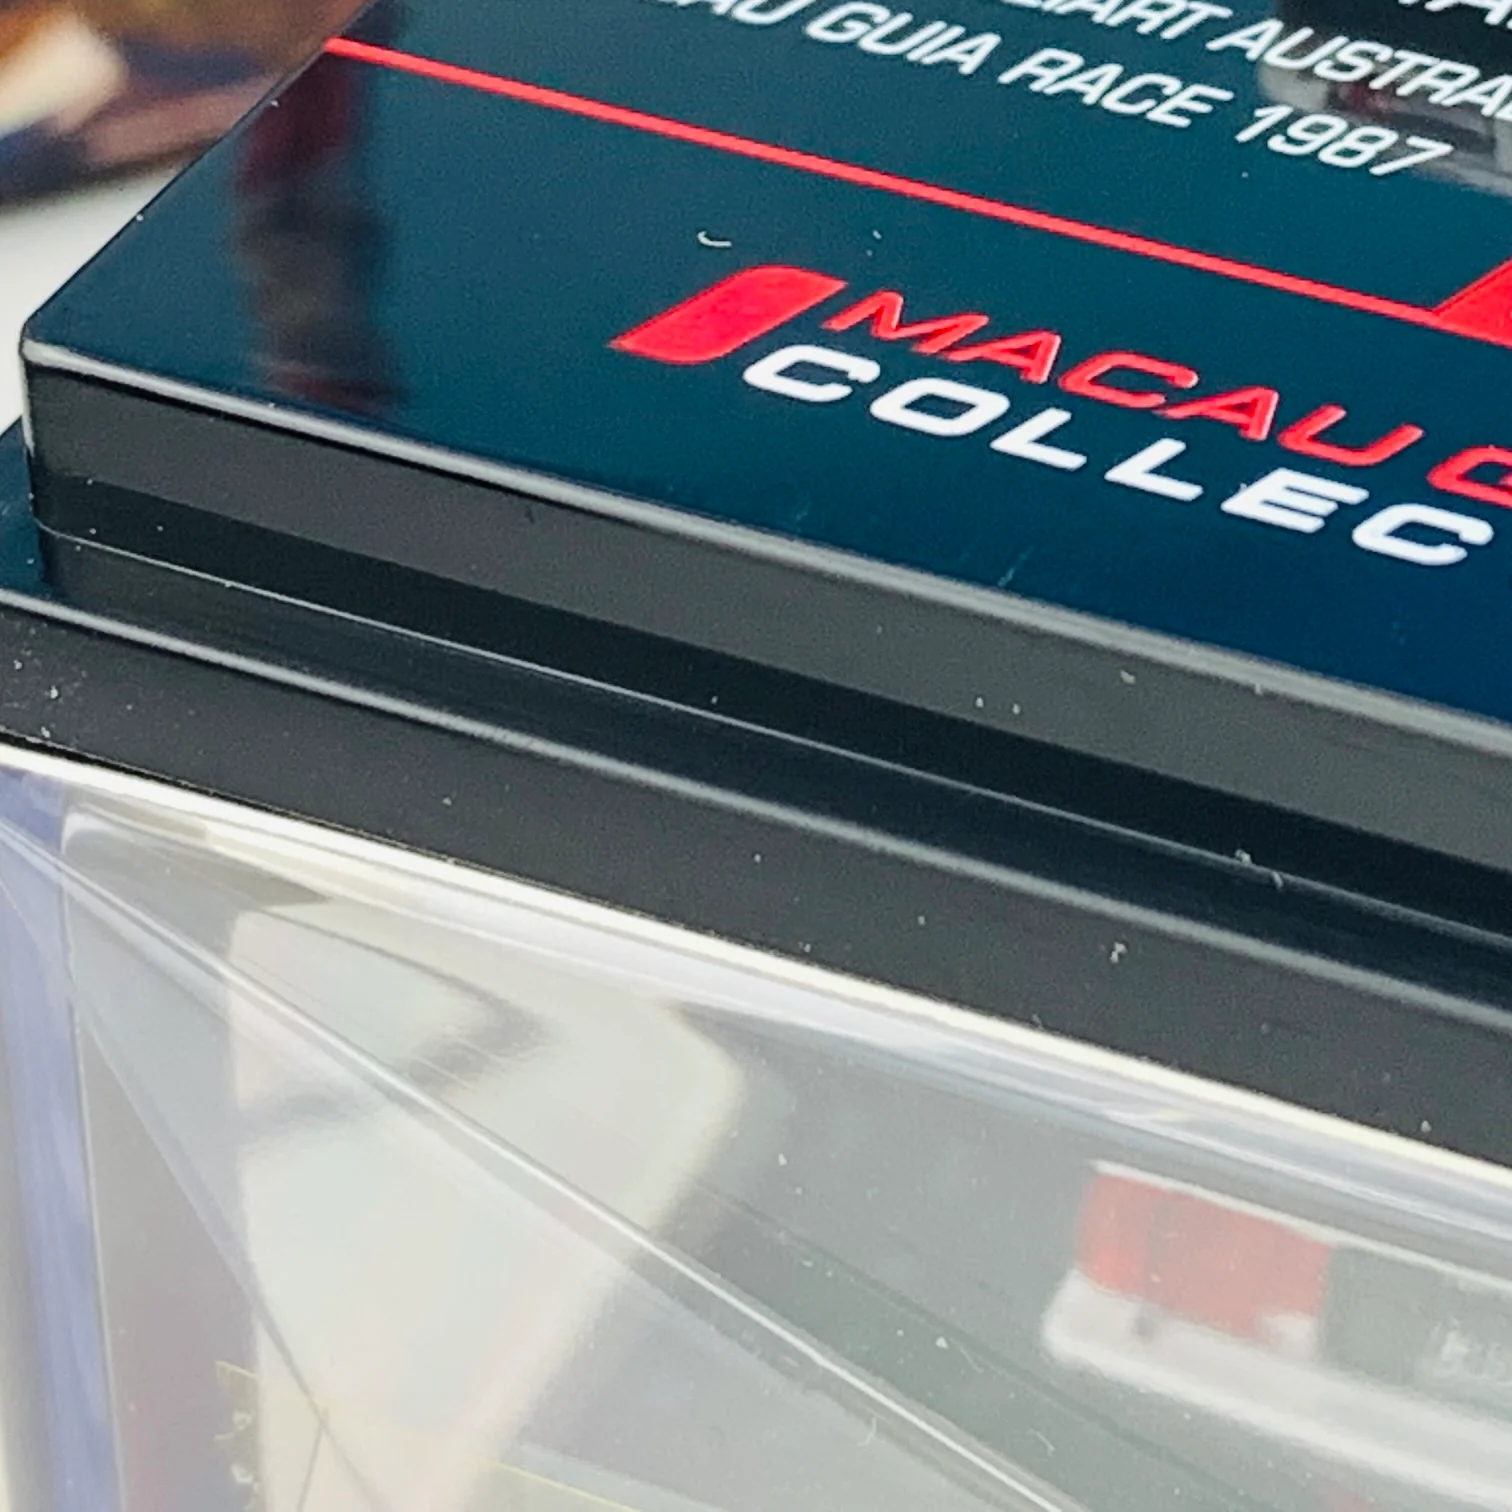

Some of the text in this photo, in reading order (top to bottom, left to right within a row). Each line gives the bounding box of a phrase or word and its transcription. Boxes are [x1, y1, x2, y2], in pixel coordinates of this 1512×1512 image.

[803, 0, 1003, 77] GUIA
[998, 46, 1234, 128] RACE
[1235, 104, 1453, 177] 1987
[821, 289, 1424, 468] MACAU
